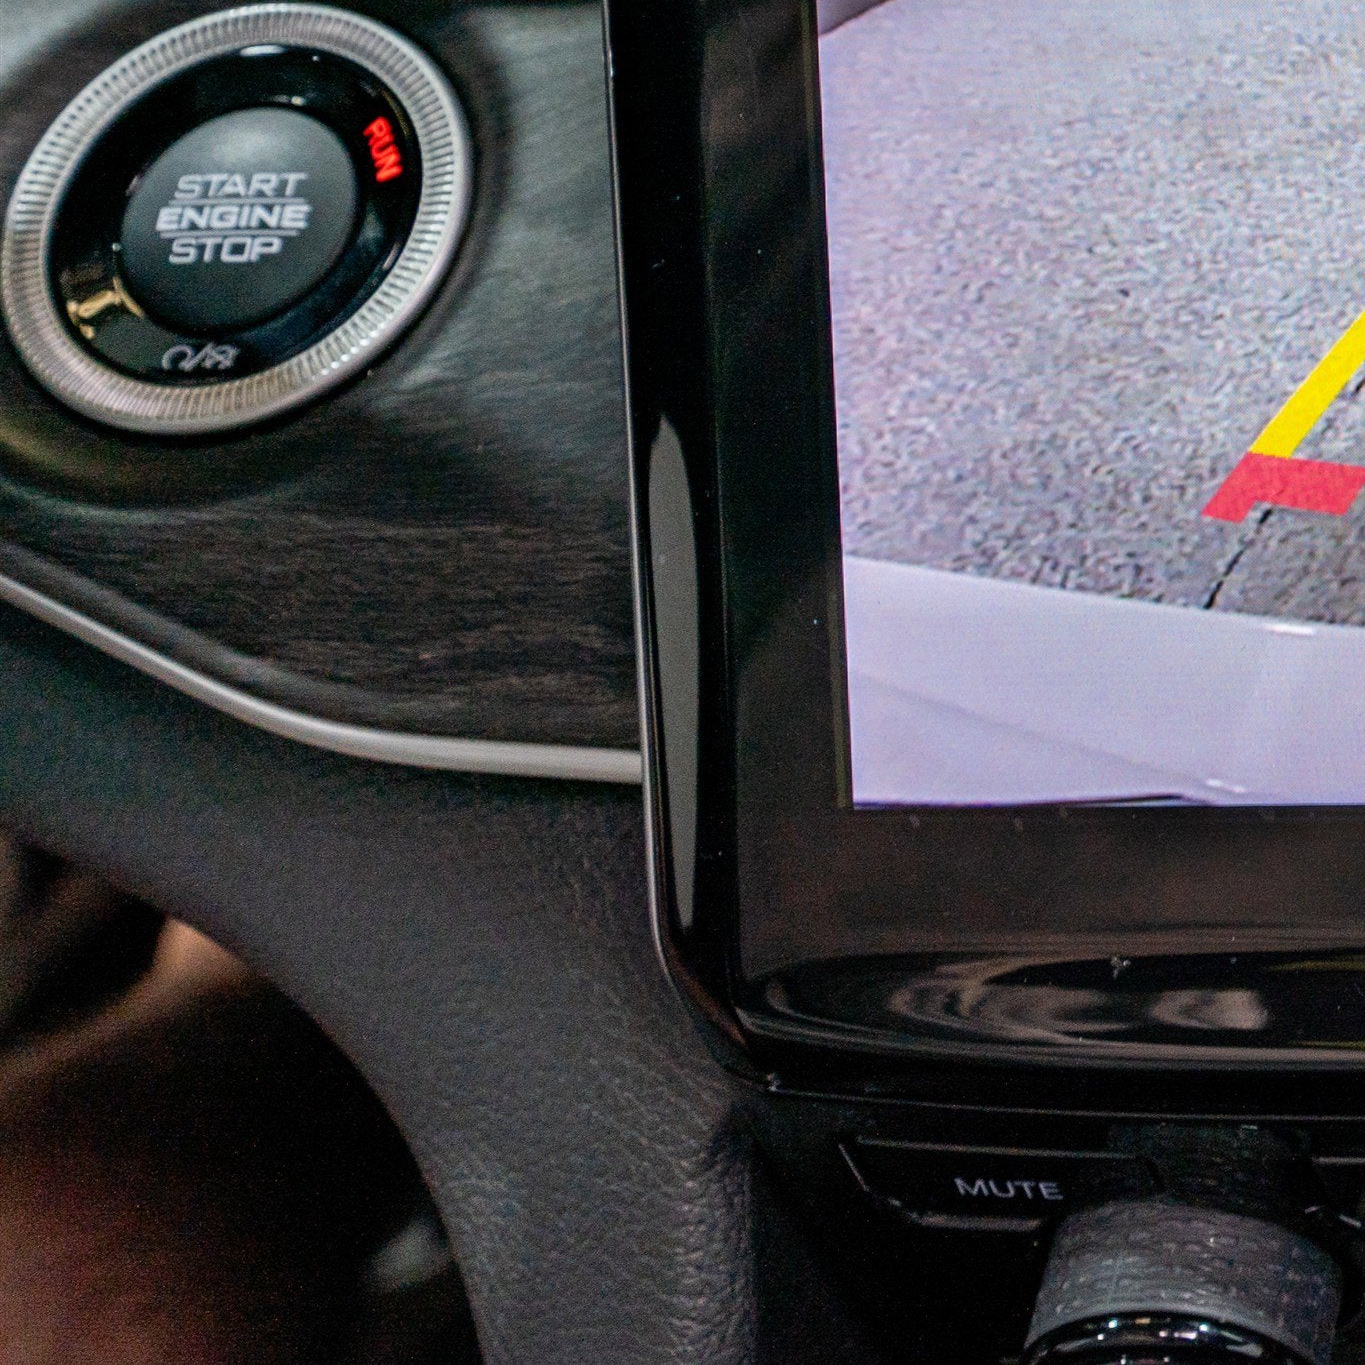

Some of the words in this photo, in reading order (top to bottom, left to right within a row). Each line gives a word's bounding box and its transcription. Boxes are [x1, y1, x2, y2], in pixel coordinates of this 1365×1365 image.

[362, 116, 403, 182] RUN
[174, 171, 309, 200] START
[154, 202, 312, 230] ENGINE
[168, 235, 285, 265] STOP
[954, 1177, 1064, 1201] MUTE
